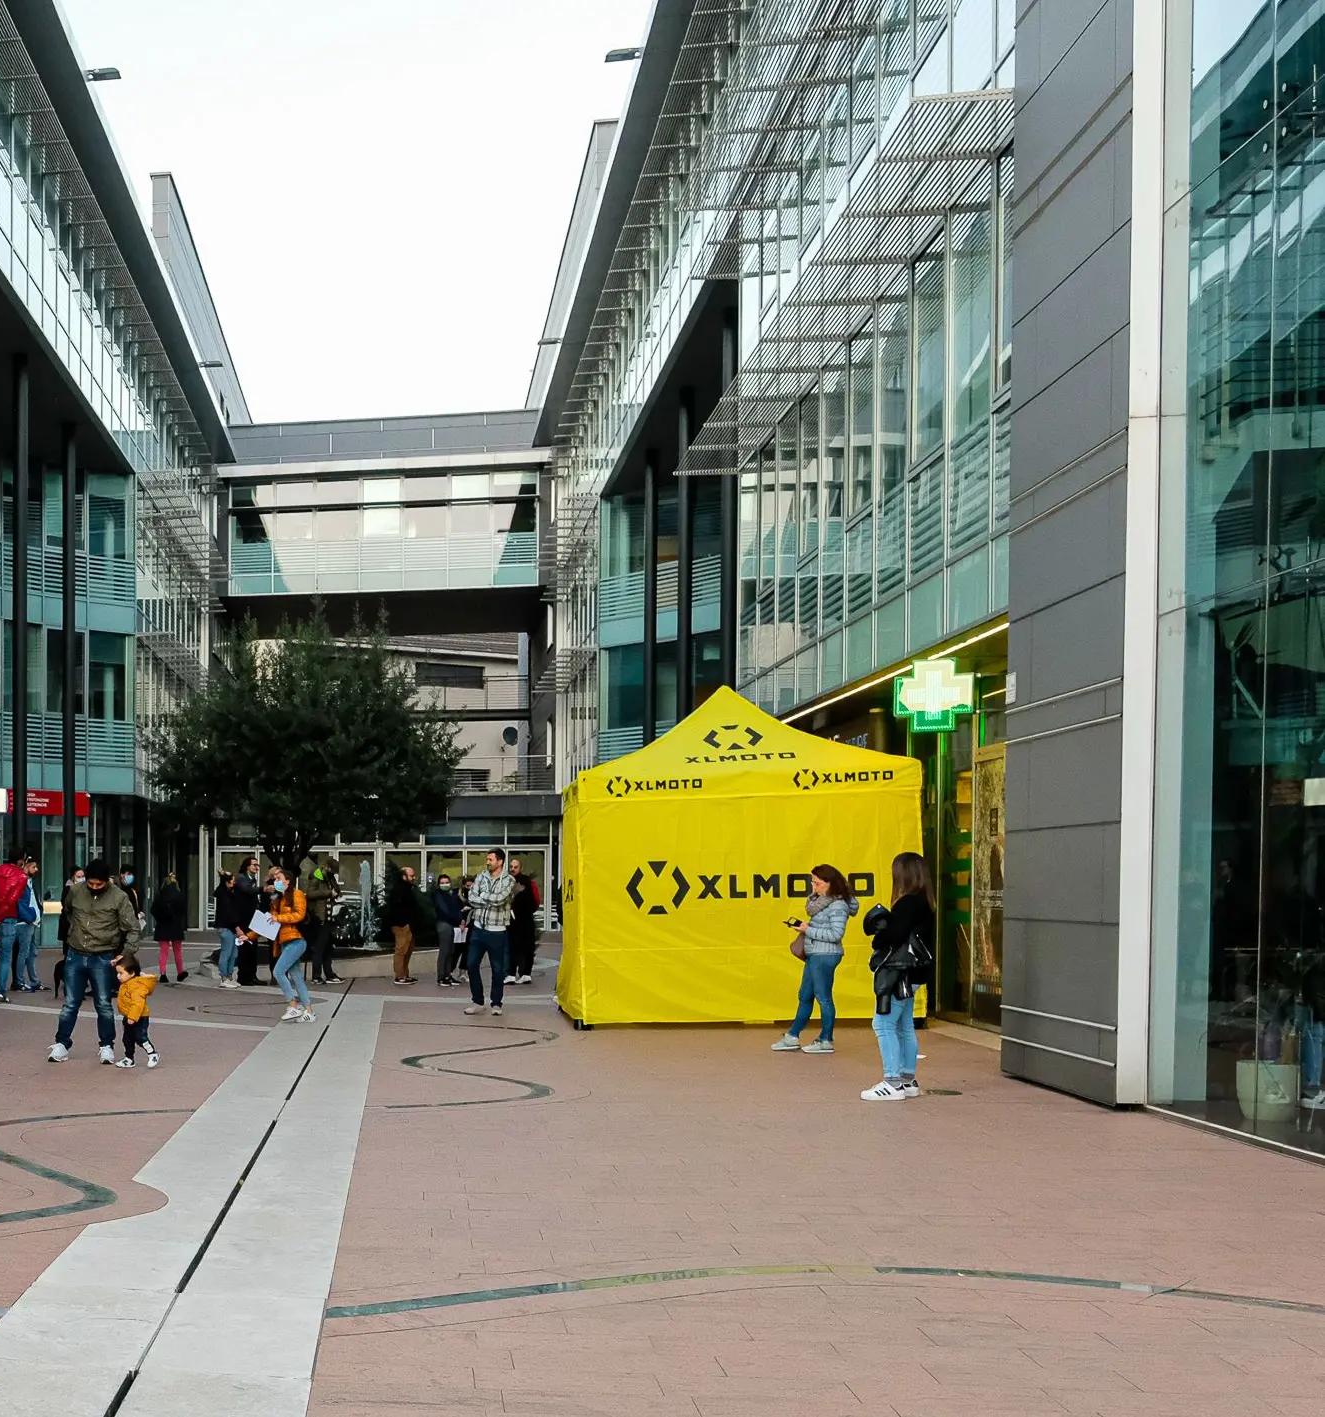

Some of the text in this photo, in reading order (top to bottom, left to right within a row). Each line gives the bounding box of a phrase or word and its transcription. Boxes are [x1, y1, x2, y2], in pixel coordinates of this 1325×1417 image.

[684, 751, 796, 764] XLMOTO
[822, 770, 894, 784] XLMOTO
[634, 778, 703, 792] XLMOTO
[697, 872, 875, 900] XLMOO
